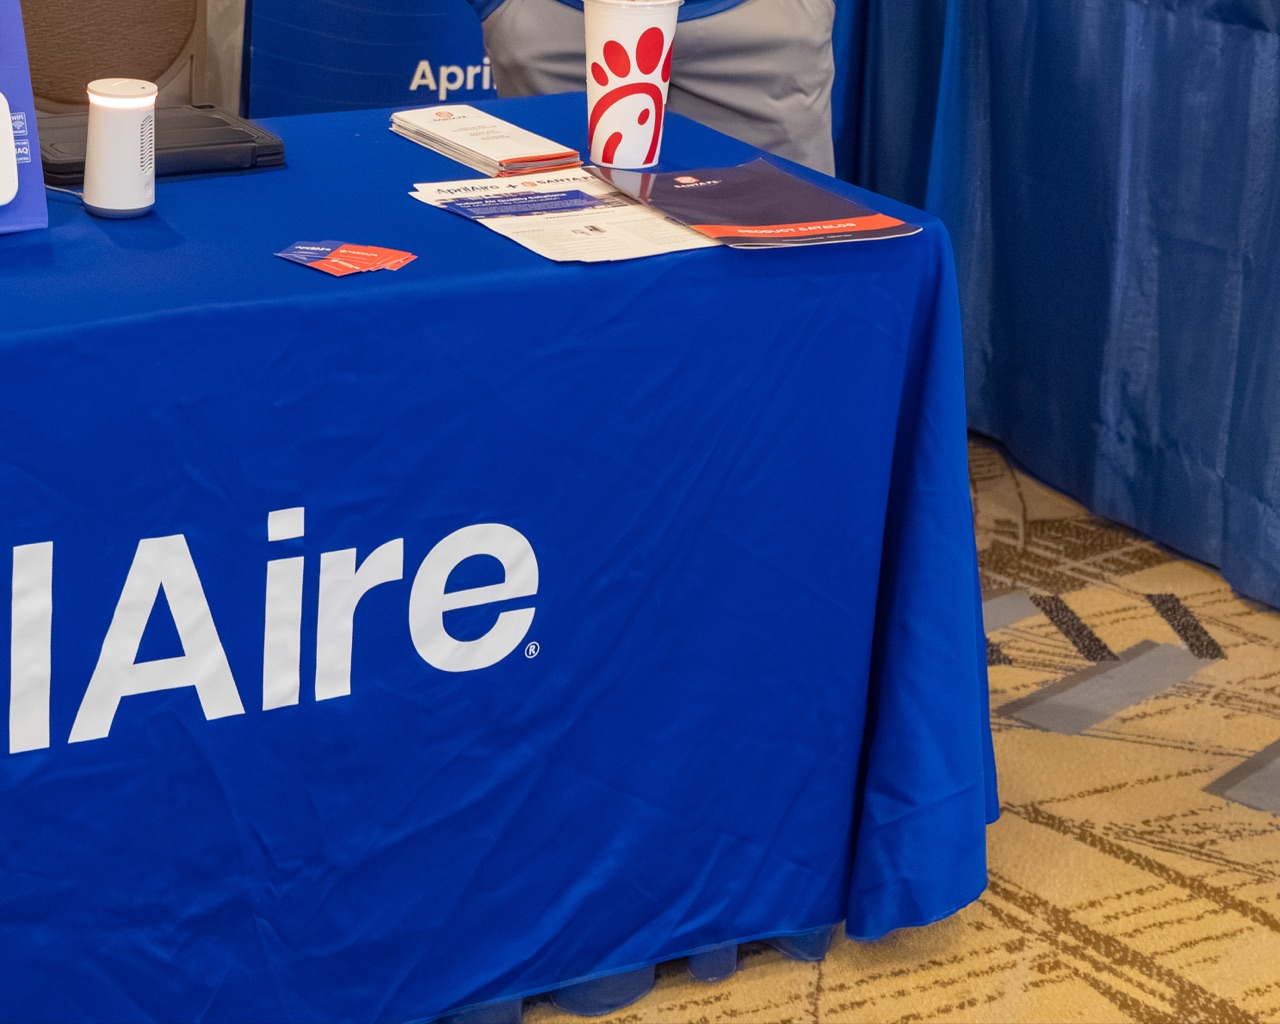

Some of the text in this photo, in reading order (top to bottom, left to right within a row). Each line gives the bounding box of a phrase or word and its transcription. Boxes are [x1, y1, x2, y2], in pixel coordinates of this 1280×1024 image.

[409, 56, 498, 101] Apri
[434, 183, 500, 195] AprilAire
[737, 221, 858, 235] PRODUCT CATALOG
